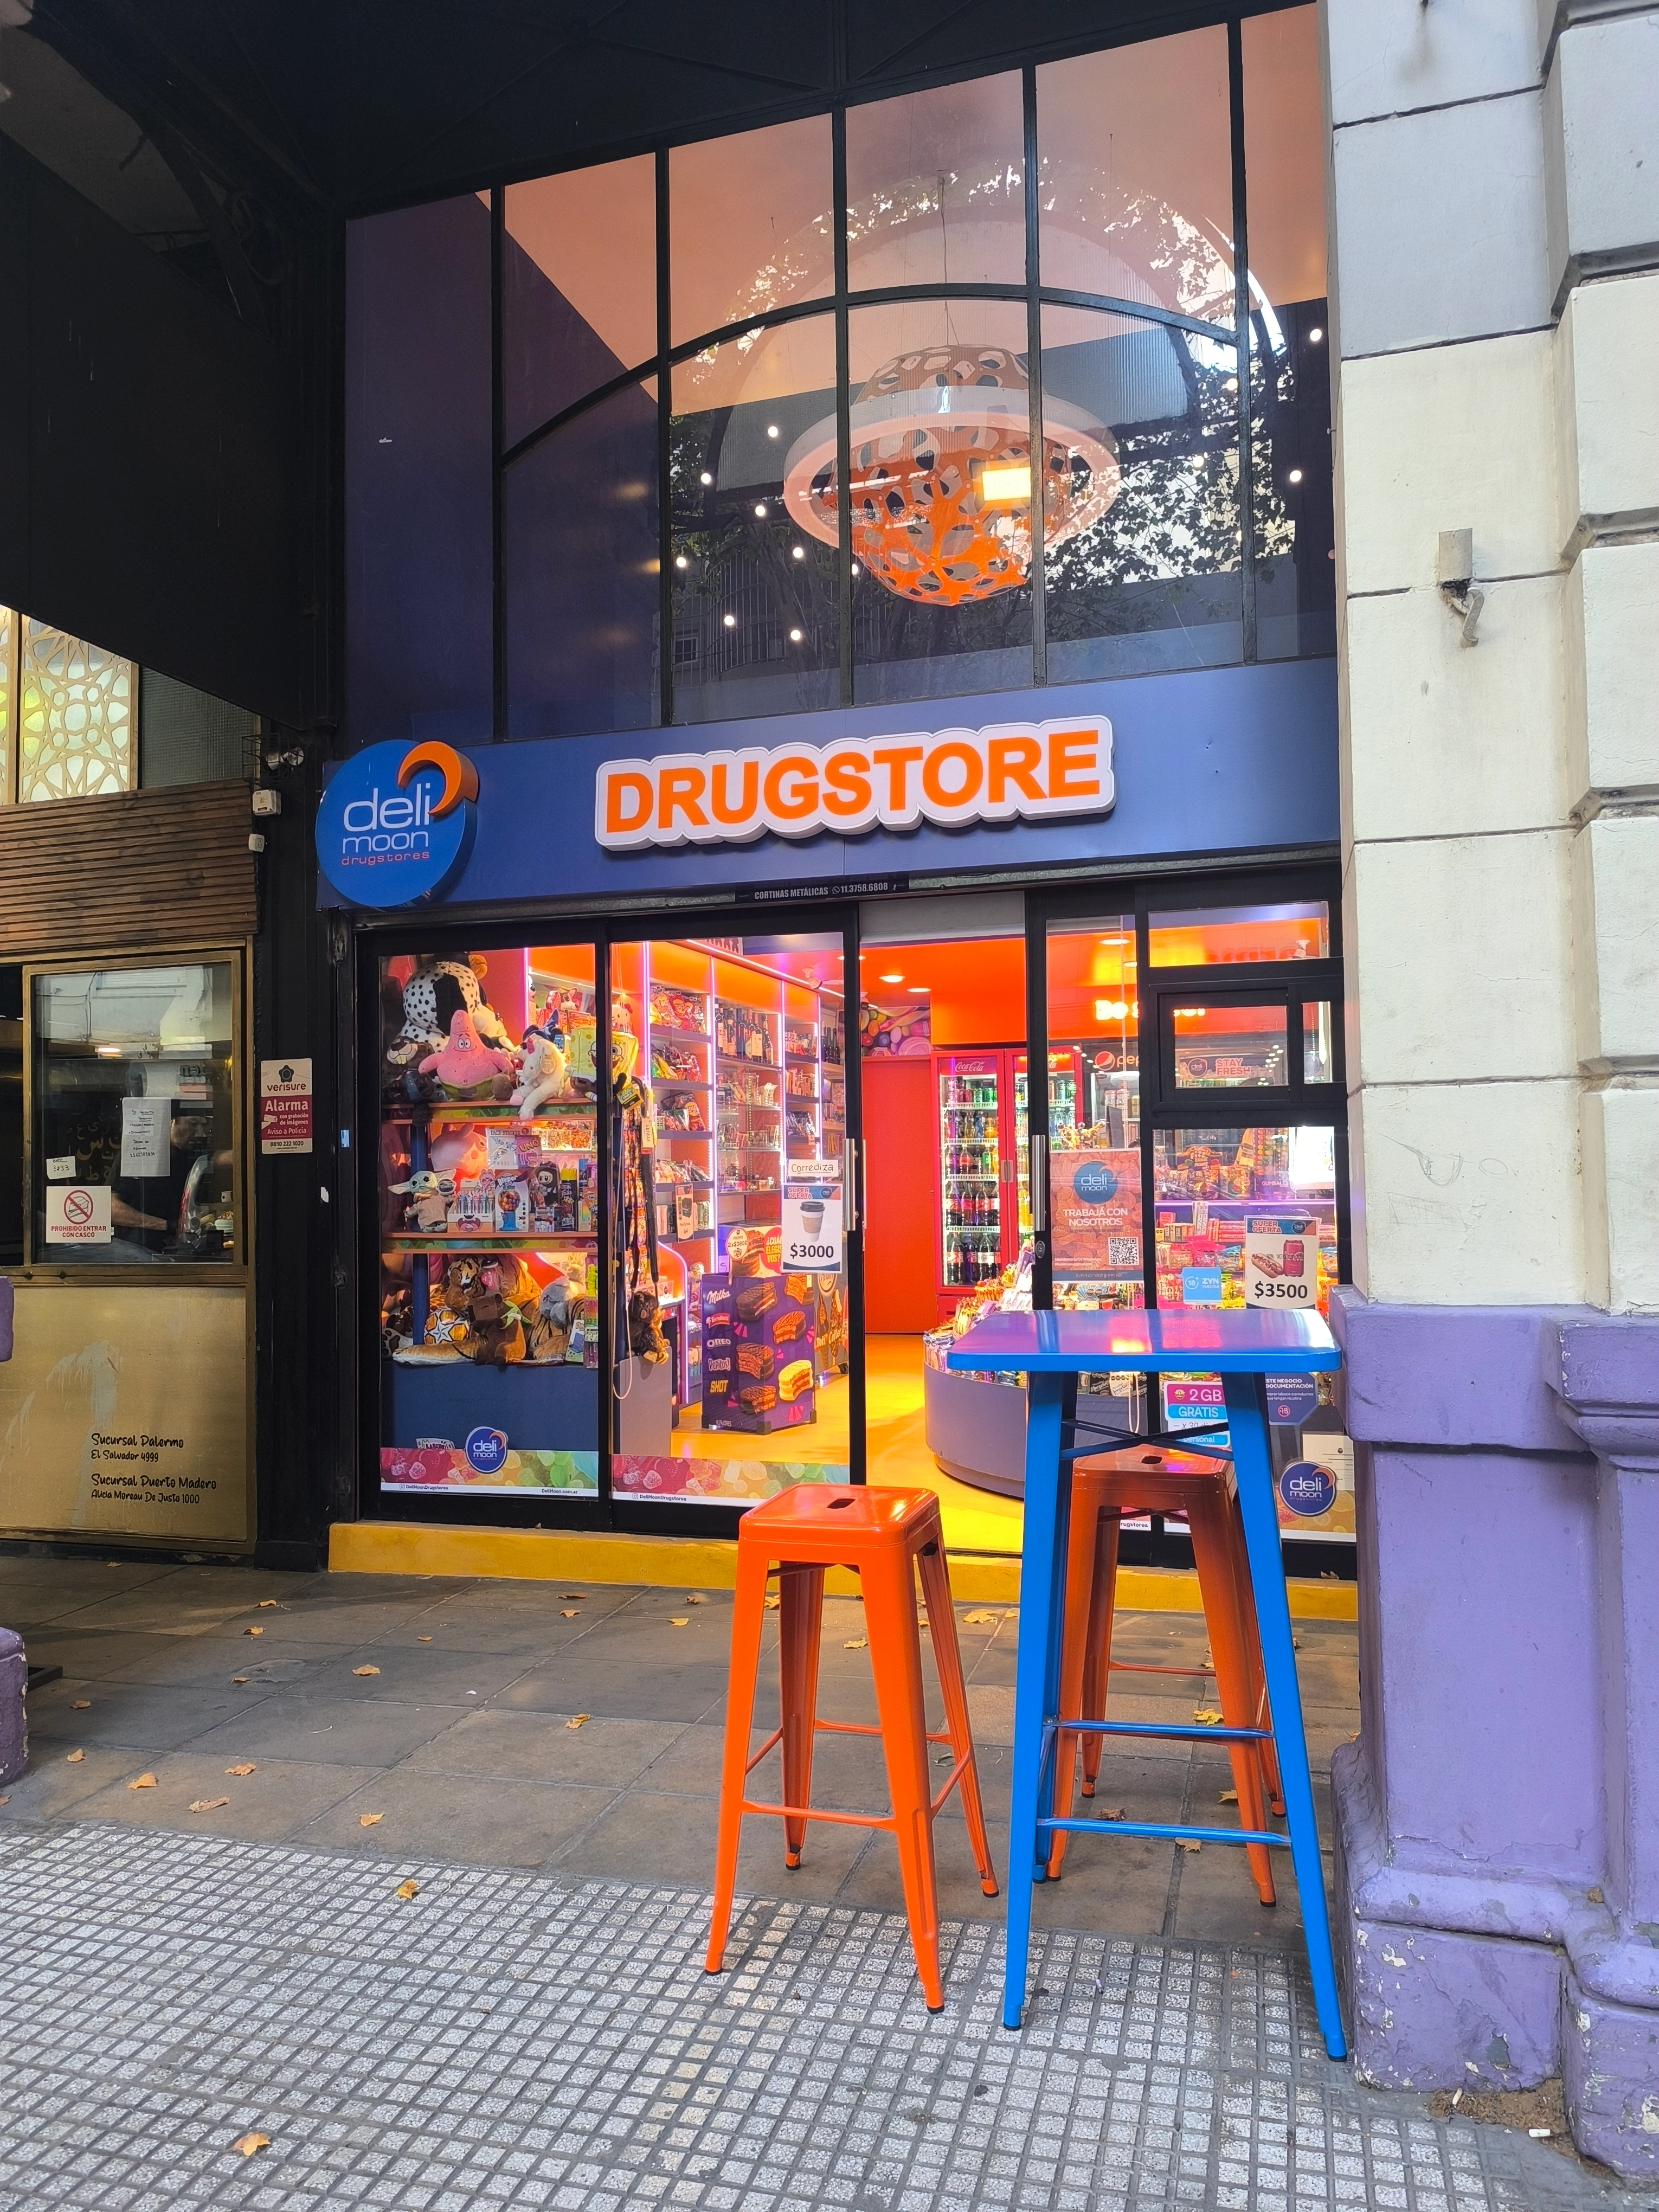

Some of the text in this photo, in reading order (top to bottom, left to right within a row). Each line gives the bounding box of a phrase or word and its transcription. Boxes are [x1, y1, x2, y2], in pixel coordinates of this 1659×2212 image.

[606, 729, 1100, 833] DRUGSTORE
[344, 782, 430, 832] deli
[342, 831, 429, 854] moon
[341, 851, 430, 866] drugstores
[755, 882, 888, 899] CORTINAS METÁLICAS 11.3758.6808
[1217, 1058, 1243, 1066] STAY
[1217, 1067, 1250, 1075] FRESH
[267, 1083, 306, 1091] verisure
[265, 1099, 308, 1111] Alarma
[519, 1140, 539, 1152] UNO
[791, 1163, 834, 1173] Corrediza
[497, 1175, 518, 1187] Bluper
[1081, 1173, 1107, 1186] deli
[1063, 1206, 1128, 1217] TRABAJÁ CON
[1069, 1218, 1123, 1226] NOSOTROS
[790, 1243, 834, 1259] $3000
[767, 1253, 781, 1263] VOS?
[706, 1288, 731, 1304] Milka
[1255, 1281, 1308, 1299] $3500
[706, 1338, 731, 1348] OREO
[828, 1328, 842, 1345] Cofler
[708, 1358, 731, 1371] Pepitos!
[710, 1380, 729, 1393] SHOT
[1189, 1388, 1222, 1401] 2 GB
[1178, 1406, 1218, 1418] GRATIS
[91, 1432, 184, 1448] Sucursal Palermo
[473, 1439, 497, 1452] deli
[91, 1449, 159, 1462] El Salvador 4999
[91, 1473, 216, 1489] Sucursal Puerto Madero
[1289, 1476, 1322, 1491] deli
[91, 1489, 200, 1503] Alicia Moreau De Justo 1000
